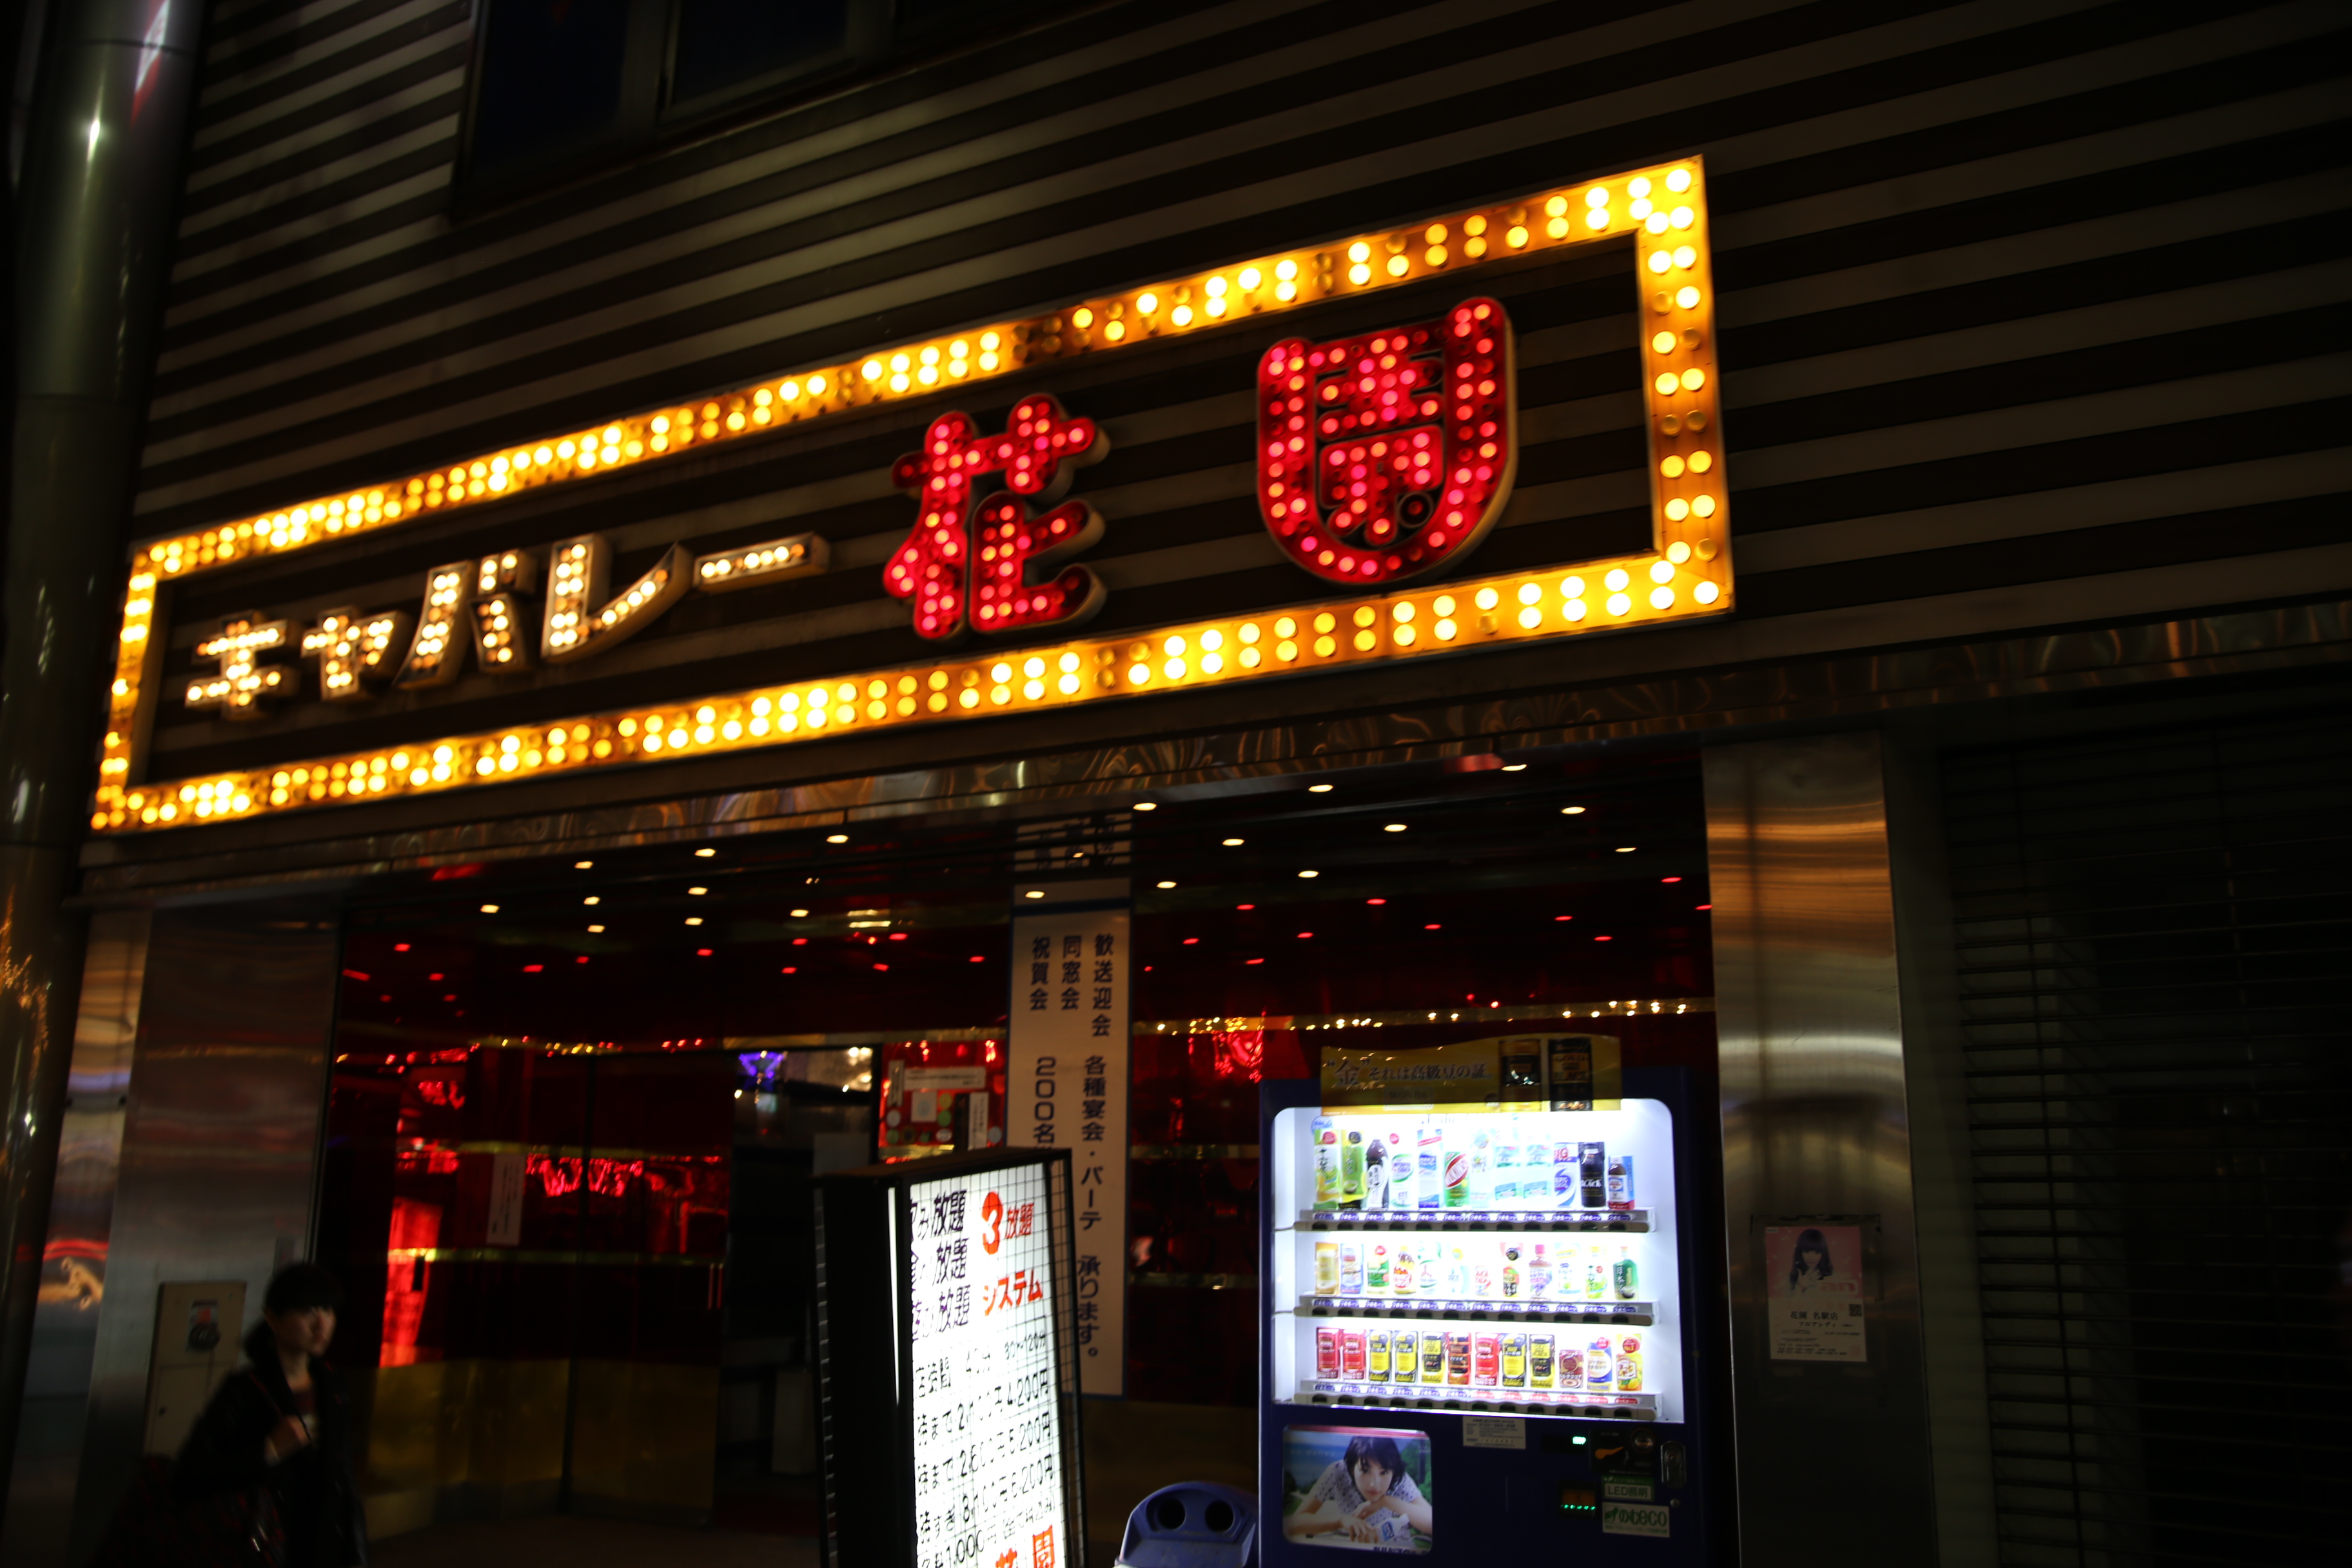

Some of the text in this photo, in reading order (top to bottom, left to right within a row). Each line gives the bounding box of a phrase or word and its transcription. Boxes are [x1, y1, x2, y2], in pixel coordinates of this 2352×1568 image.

[185, 533, 828, 720] キャバレー
[1030, 936, 1051, 1011] 祝賀会
[1061, 936, 1082, 1011] 同窓会
[1092, 933, 1114, 1037] 歓送迎会
[1034, 1057, 1056, 1149] 200名
[983, 1269, 1043, 1317] システム
[1077, 1255, 1101, 1357] 承ります。
